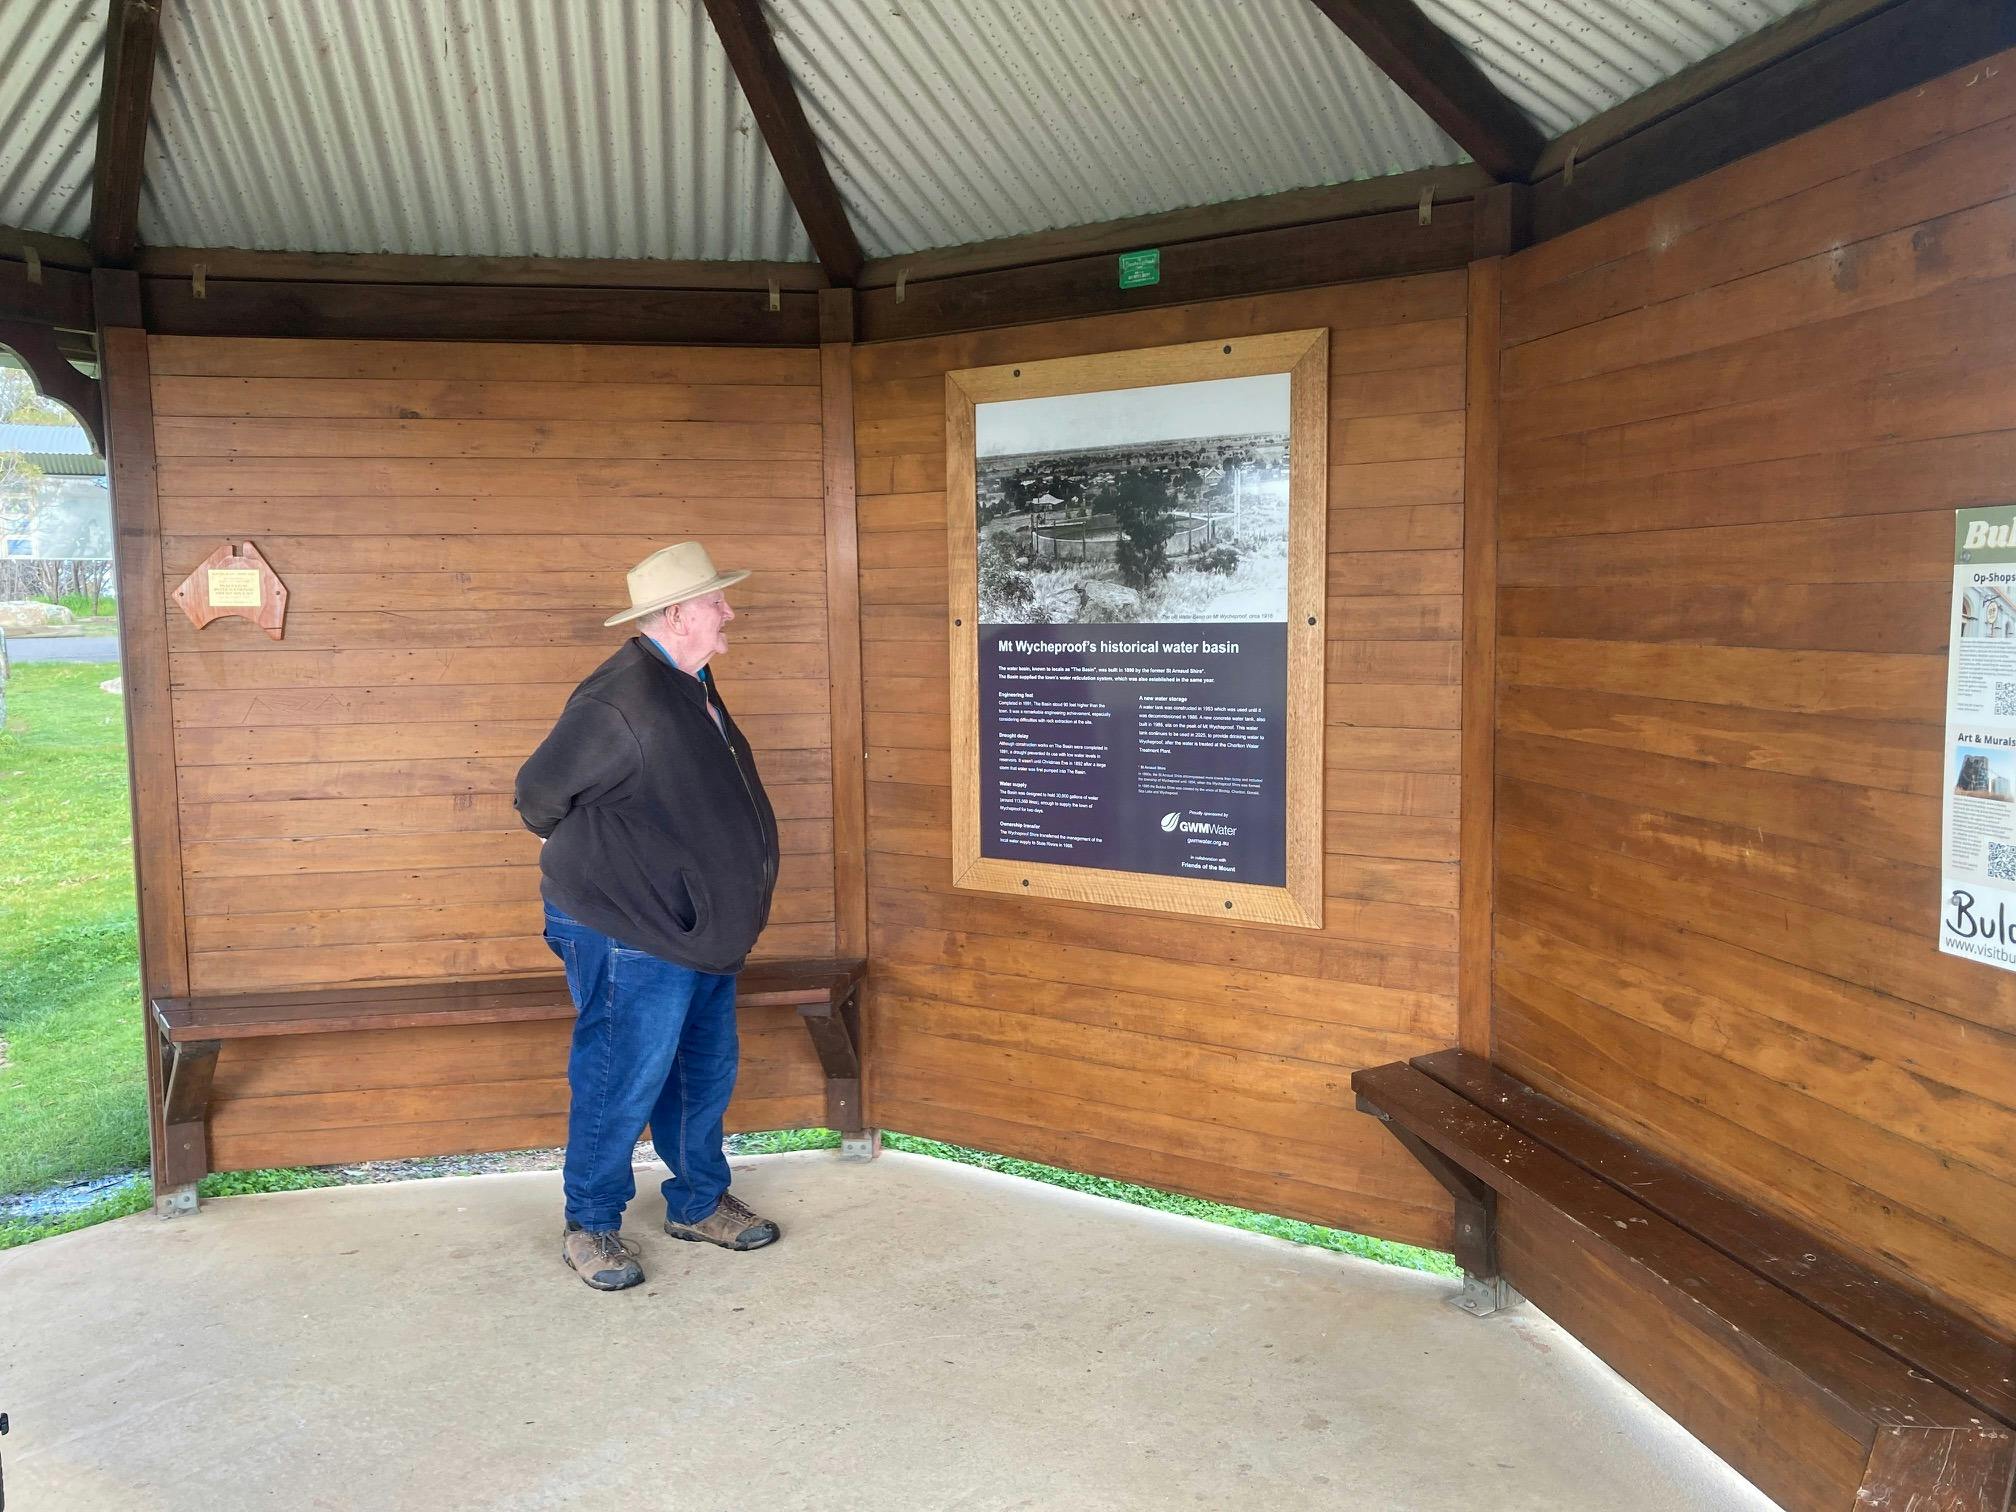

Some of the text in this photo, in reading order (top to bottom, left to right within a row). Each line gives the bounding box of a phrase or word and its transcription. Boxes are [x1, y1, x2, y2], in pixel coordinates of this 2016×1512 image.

[1973, 573, 2016, 584] Op-Shops
[999, 640, 1239, 654] Mt Wycheproof's historical water basin
[1958, 733, 2016, 747] Art & Murals
[1180, 821, 1237, 835] GWMWater
[1187, 838, 1229, 846] gwmwater.org.au
[1945, 936, 2016, 964] www.visitbu
